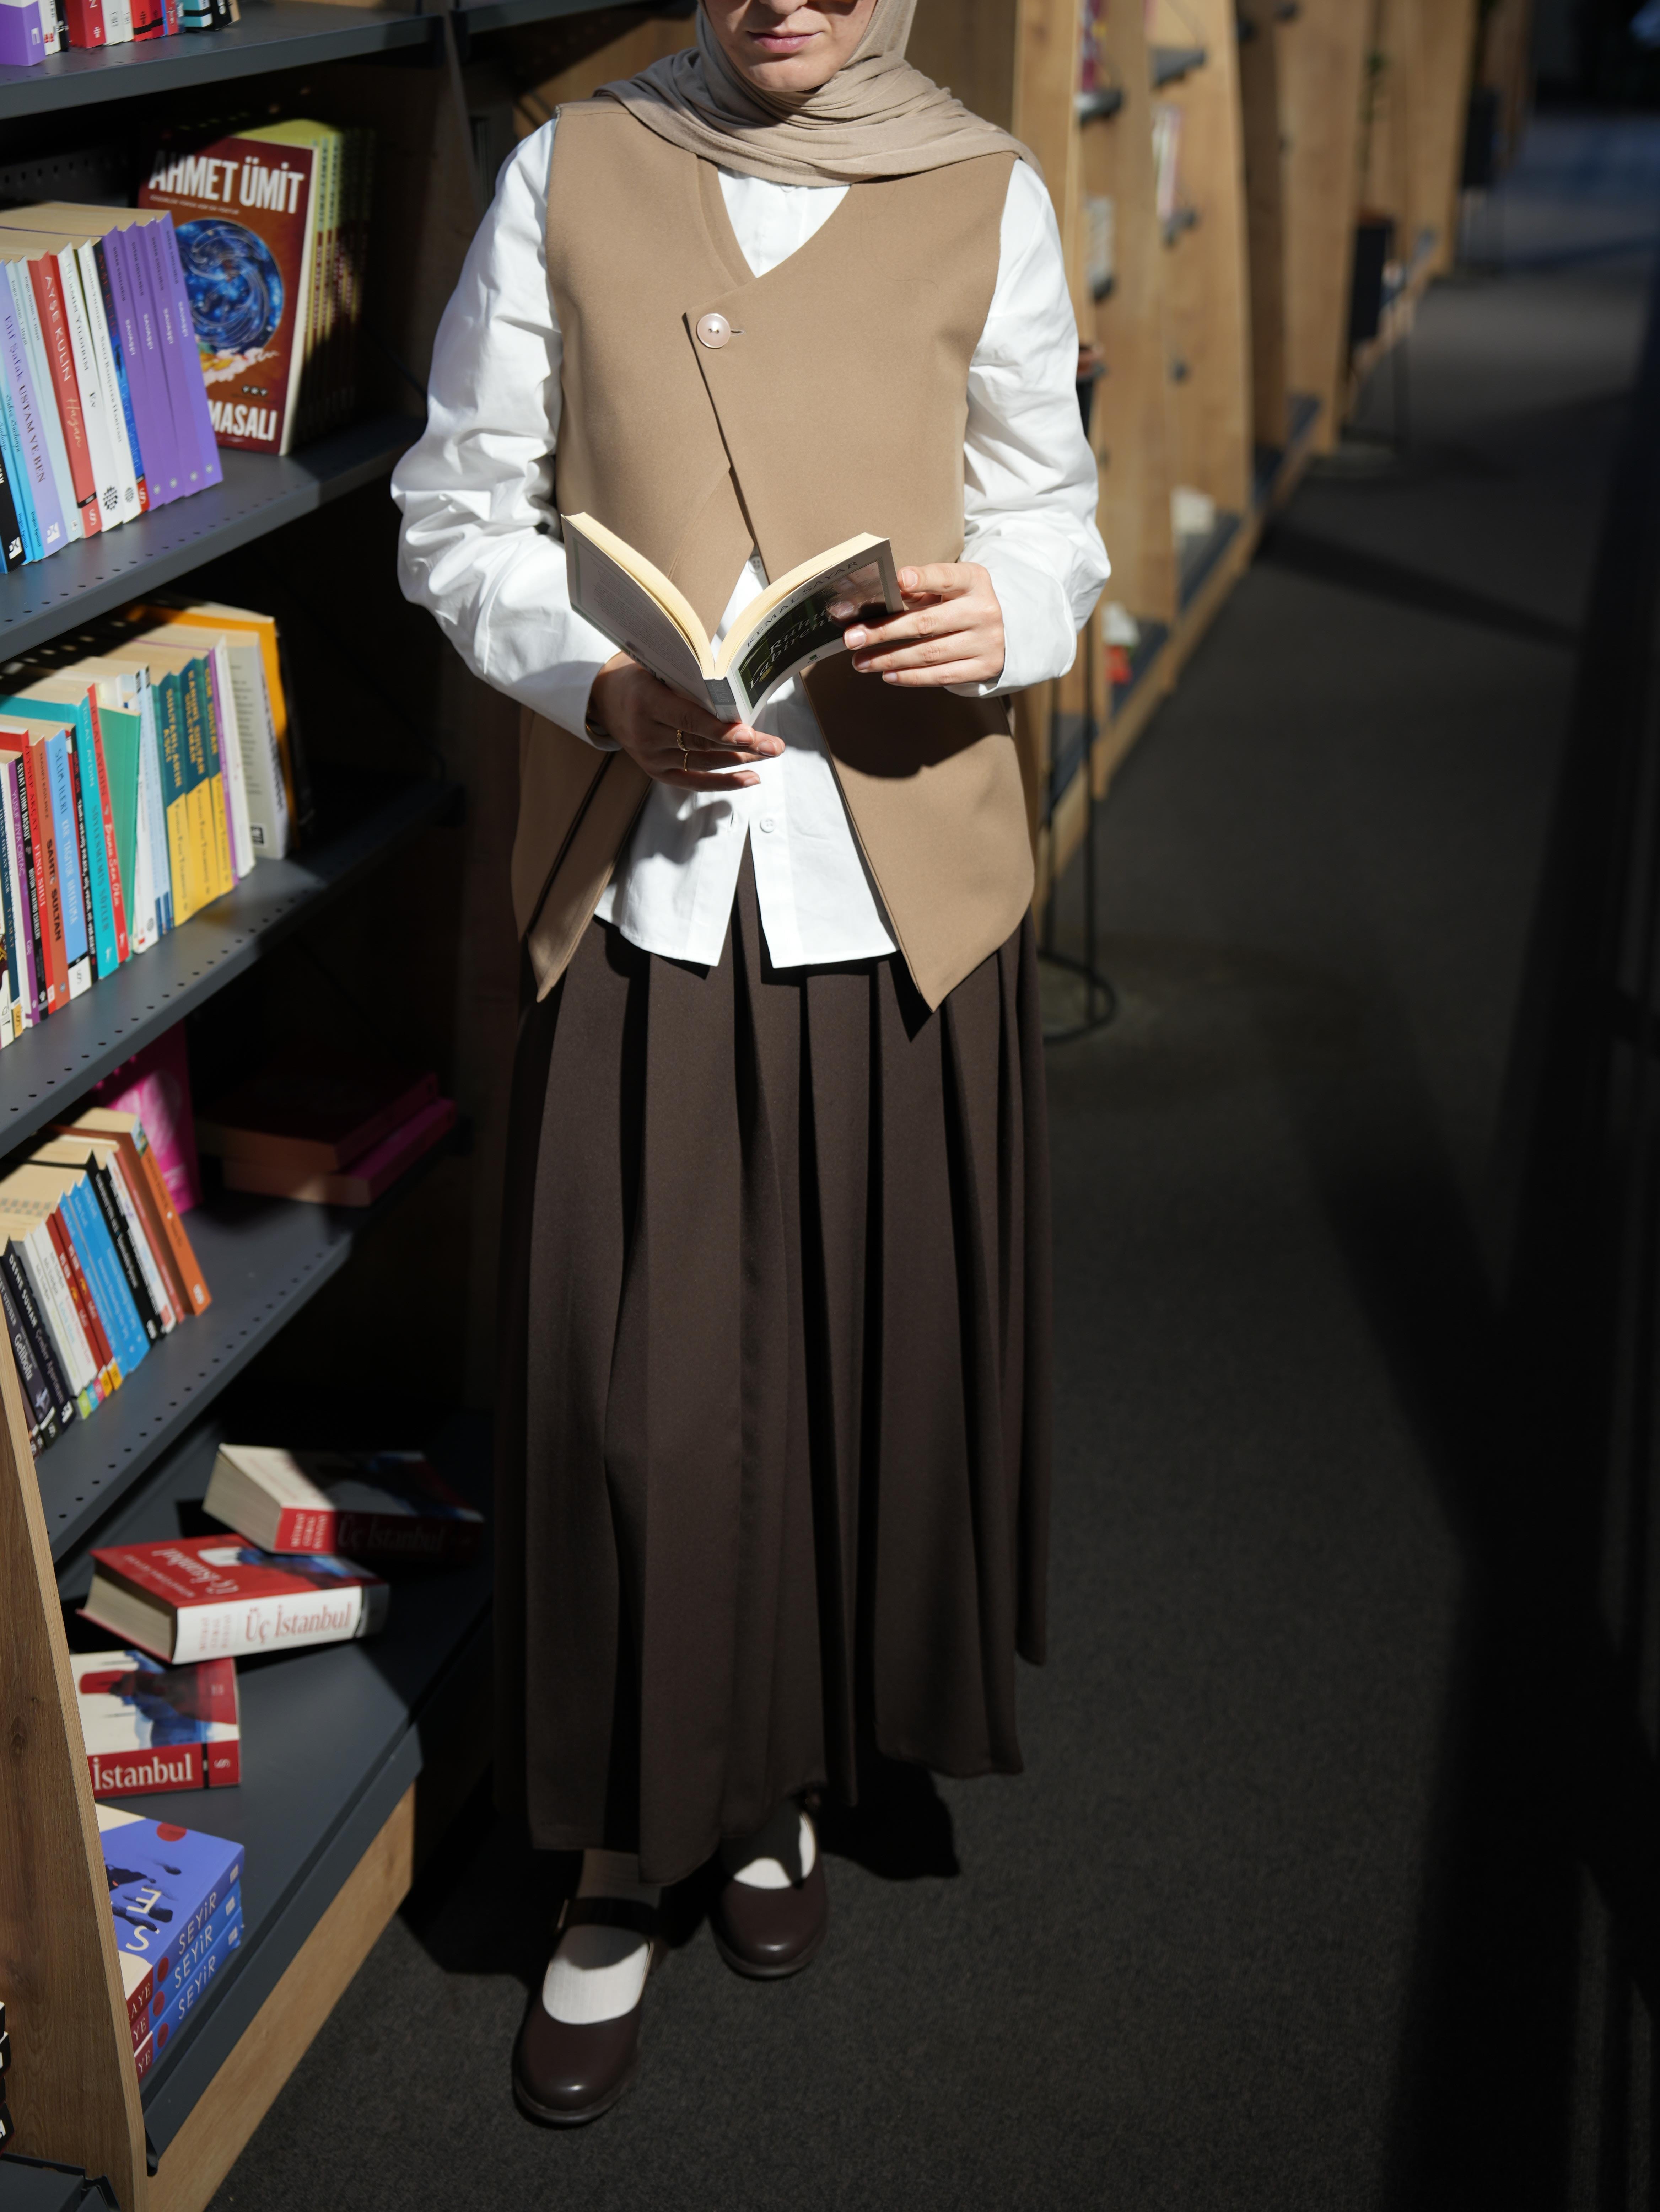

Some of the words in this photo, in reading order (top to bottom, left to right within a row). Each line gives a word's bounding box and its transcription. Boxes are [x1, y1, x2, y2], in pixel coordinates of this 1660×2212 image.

[148, 150, 239, 207] AHMET
[240, 156, 305, 214] ÜMİT
[5, 316, 15, 340] Elif
[43, 275, 61, 323] AYŞE
[53, 327, 73, 381] KULİN
[8, 343, 25, 382] Şafak
[17, 384, 36, 433] USTAM
[206, 399, 277, 441] MASALI
[28, 435, 39, 454] VE
[33, 455, 46, 483] BEN
[747, 598, 799, 648] KEMAL
[803, 560, 858, 596] SAYAR
[769, 603, 839, 655] Ruhu
[16, 763, 26, 786] CEVAT
[54, 749, 64, 783] SELİM
[11, 790, 20, 818] YUSUF
[33, 844, 43, 876] FENG
[85, 749, 96, 787] AYDIN
[99, 891, 109, 932] SÖZLER
[107, 858, 118, 882] Sen
[37, 878, 46, 906] SHUI
[50, 888, 64, 941] SULTAN
[3, 1294, 17, 1327] UZUNER
[6, 1253, 25, 1290] DEFNE
[19, 1289, 39, 1328] SUMAN
[15, 1333, 33, 1381] Gelibolu
[246, 1608, 270, 1645] Üç
[274, 1602, 353, 1640] İstanbul
[93, 1752, 193, 1791] İstanbul
[179, 1892, 216, 1955] SEYİR
[174, 1924, 212, 1989] SEYİR
[178, 1955, 216, 2020] SEYİR
